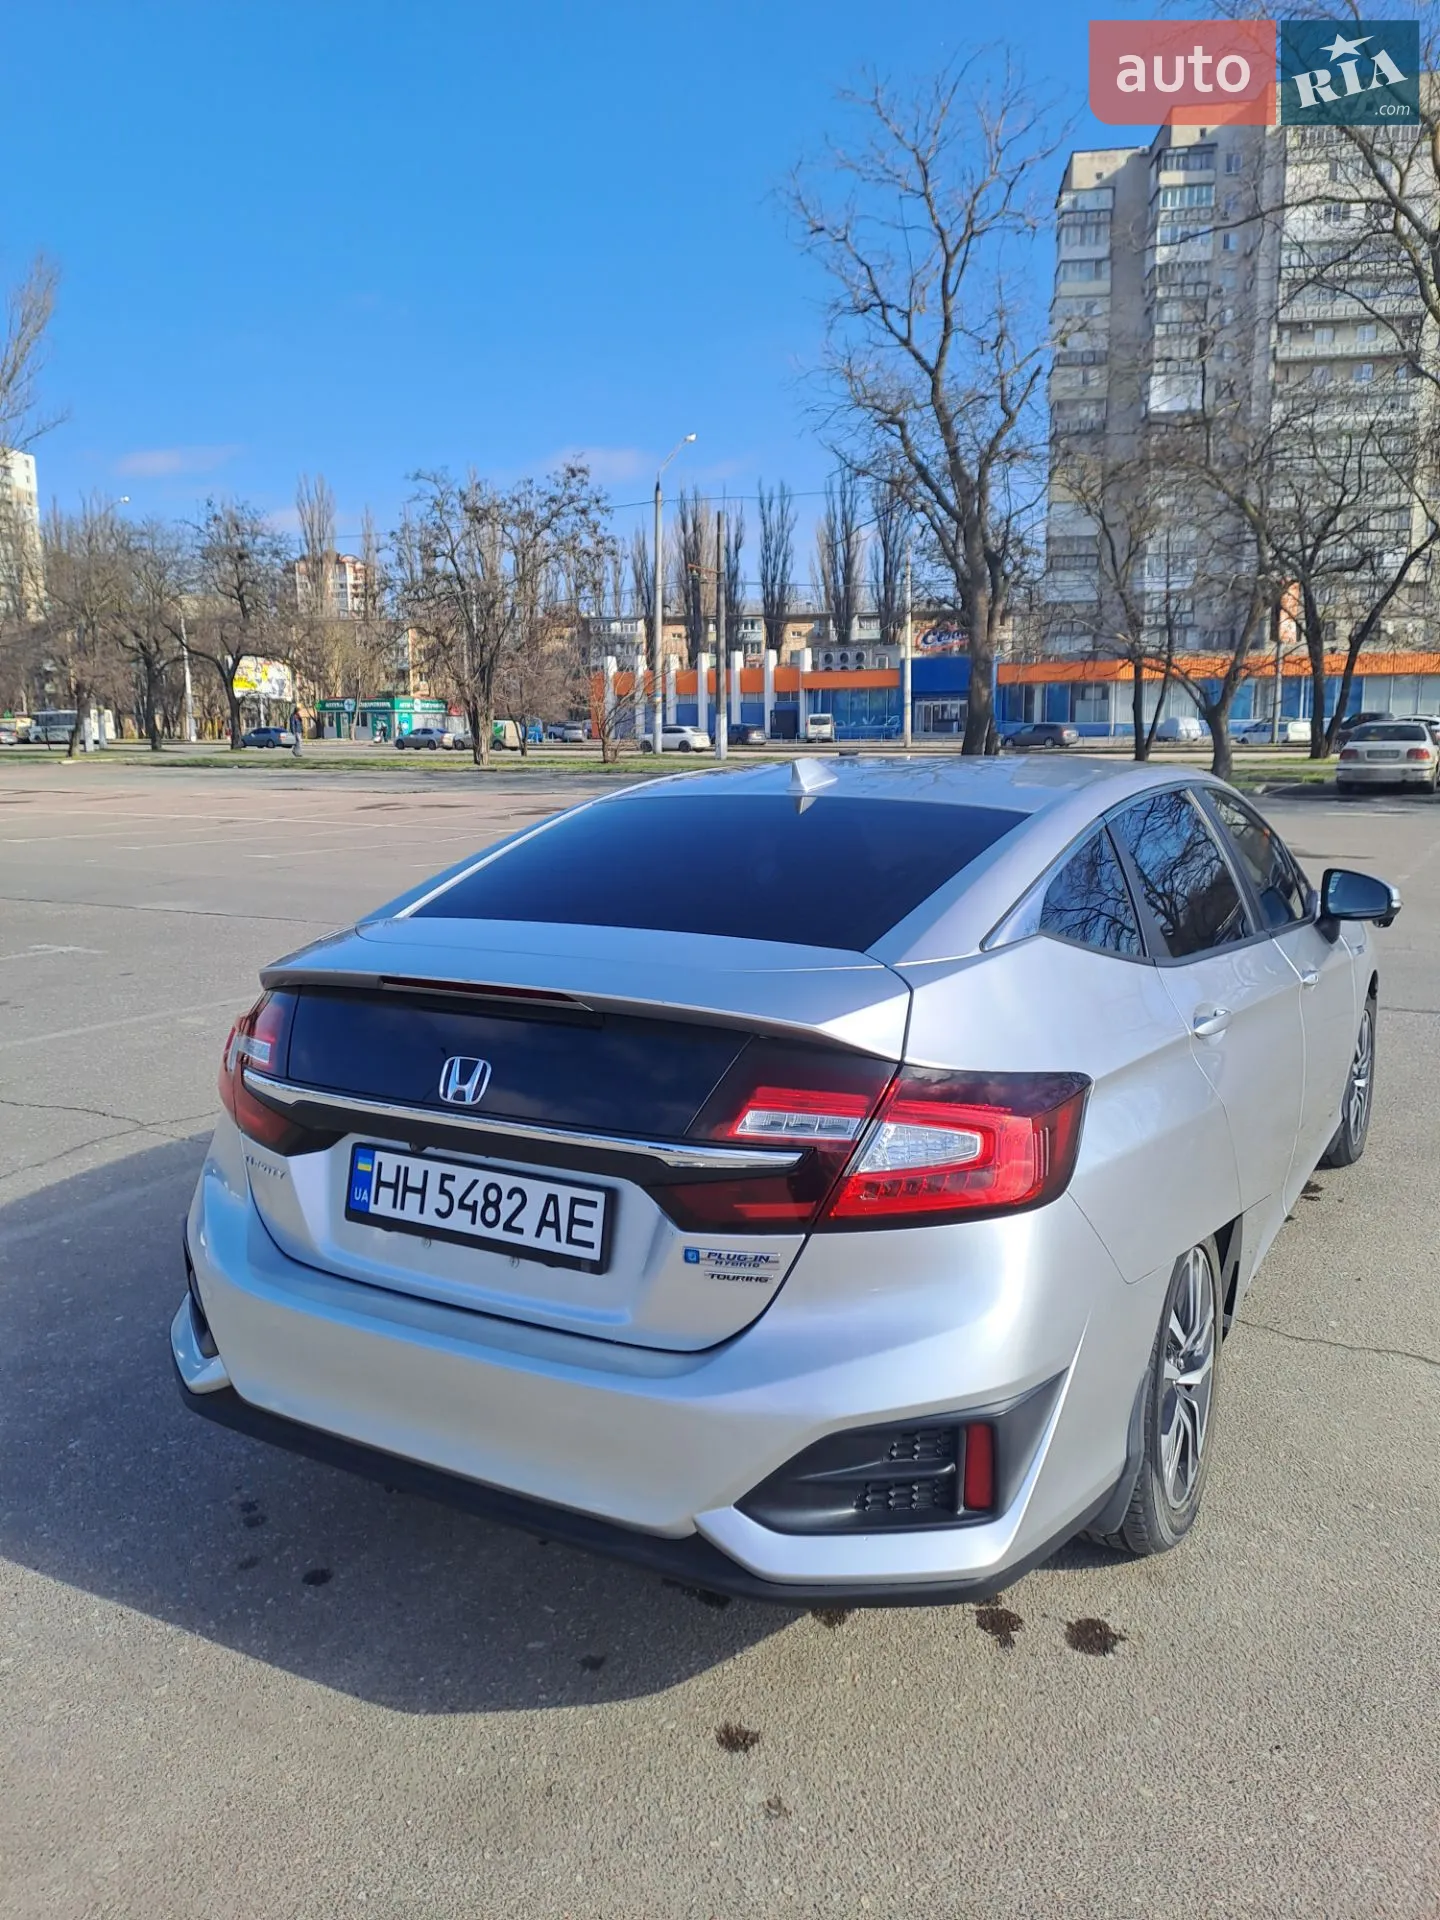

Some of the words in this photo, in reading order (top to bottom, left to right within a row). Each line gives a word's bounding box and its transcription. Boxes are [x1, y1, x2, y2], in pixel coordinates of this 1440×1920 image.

[353, 1187, 369, 1203] UA
[373, 1161, 429, 1215] HH
[434, 1172, 528, 1236] 5482
[534, 1192, 599, 1249] AE
[707, 1251, 770, 1263] PLUG-IN
[708, 1272, 769, 1283] TOURING
